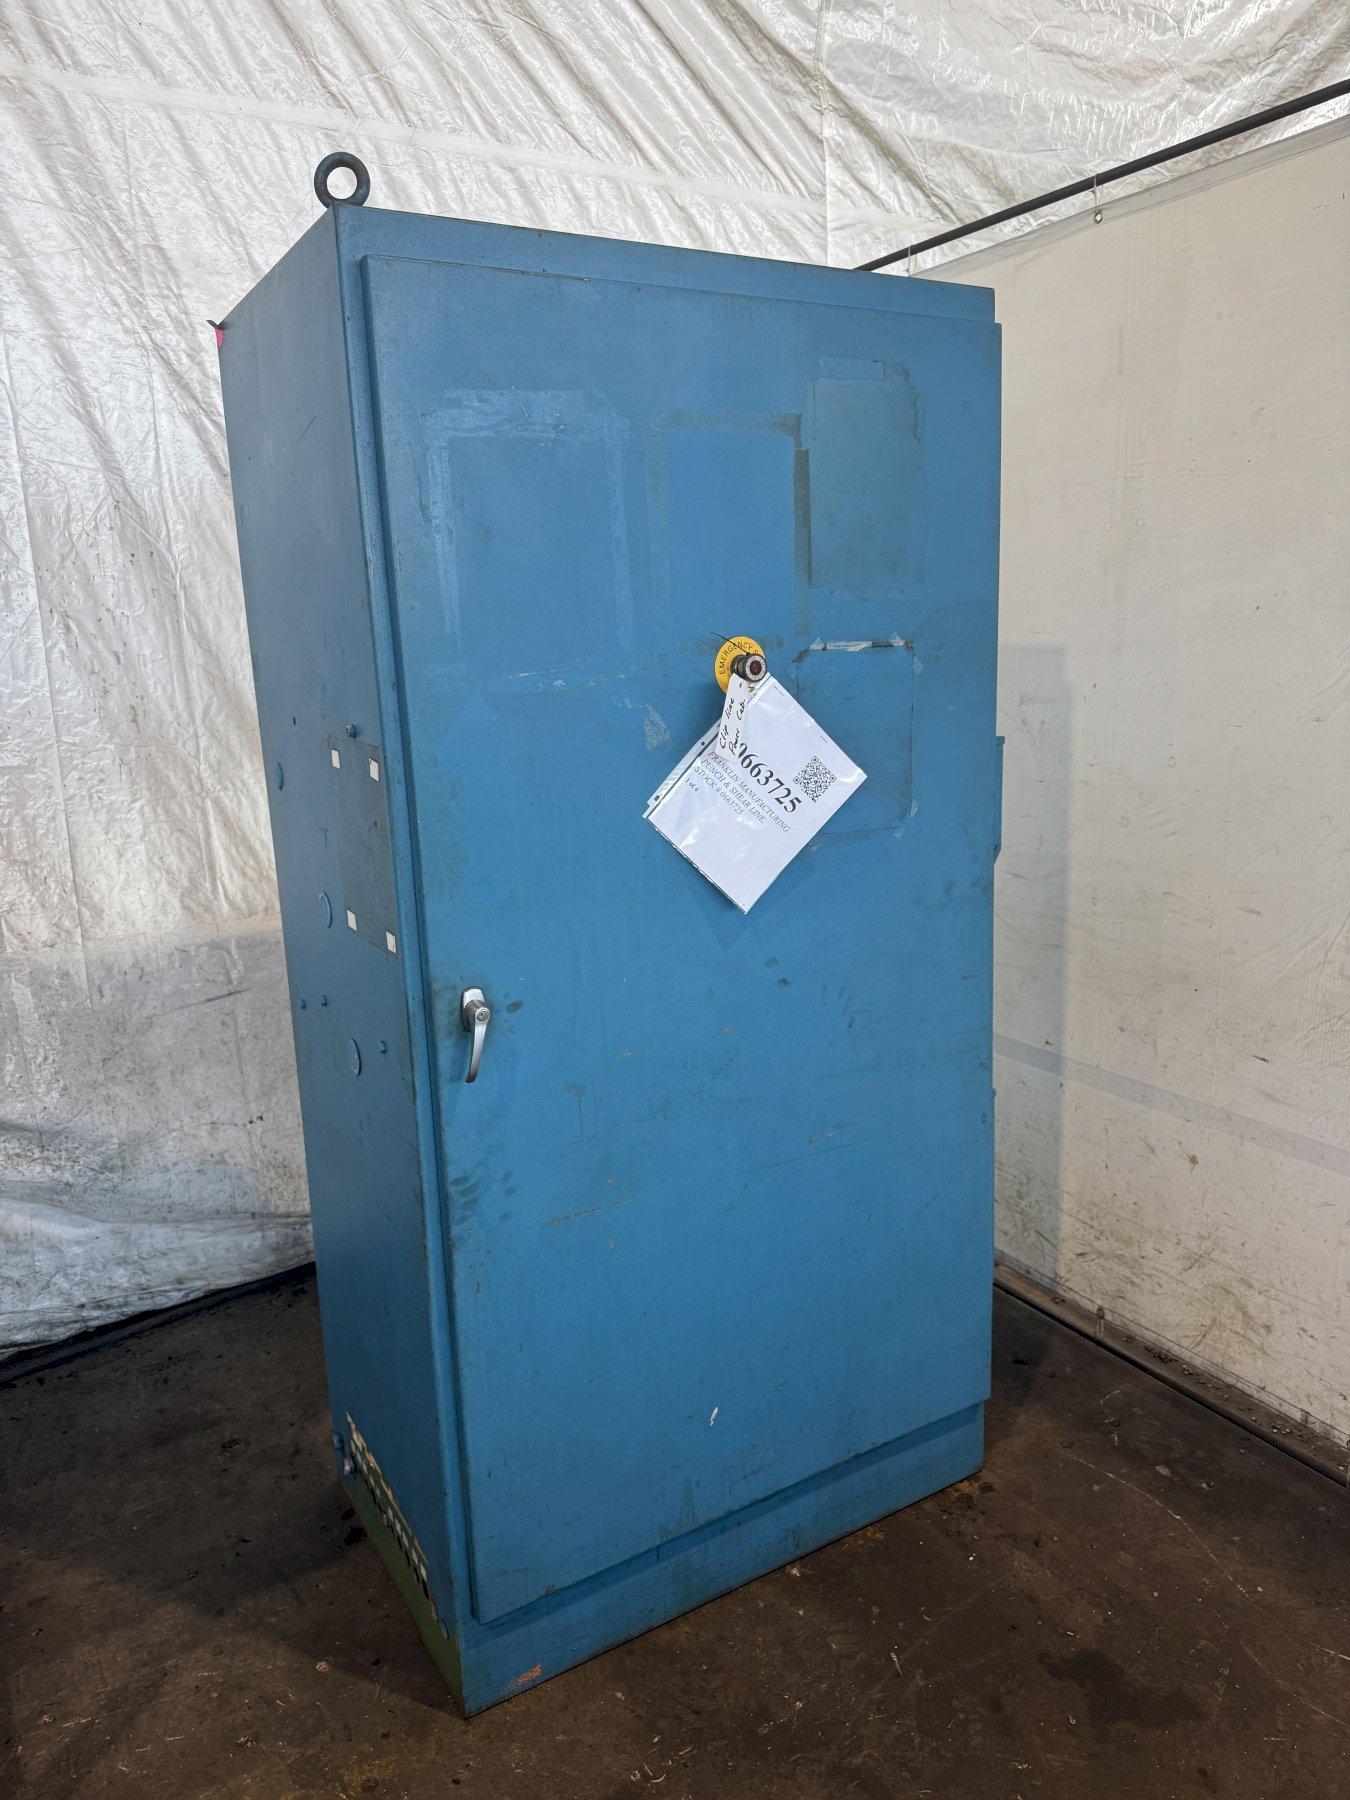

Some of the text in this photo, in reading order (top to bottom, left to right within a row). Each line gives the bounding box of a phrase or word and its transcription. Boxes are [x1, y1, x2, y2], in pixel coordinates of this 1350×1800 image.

[719, 641, 754, 675] EMERGENCY
[694, 766, 744, 814] STOCK # 0663725
[701, 759, 726, 782] PUNCH
[724, 780, 731, 788] &
[730, 785, 750, 807] SHEAR
[708, 751, 791, 833] FRANKLIN MANUFACTURING
